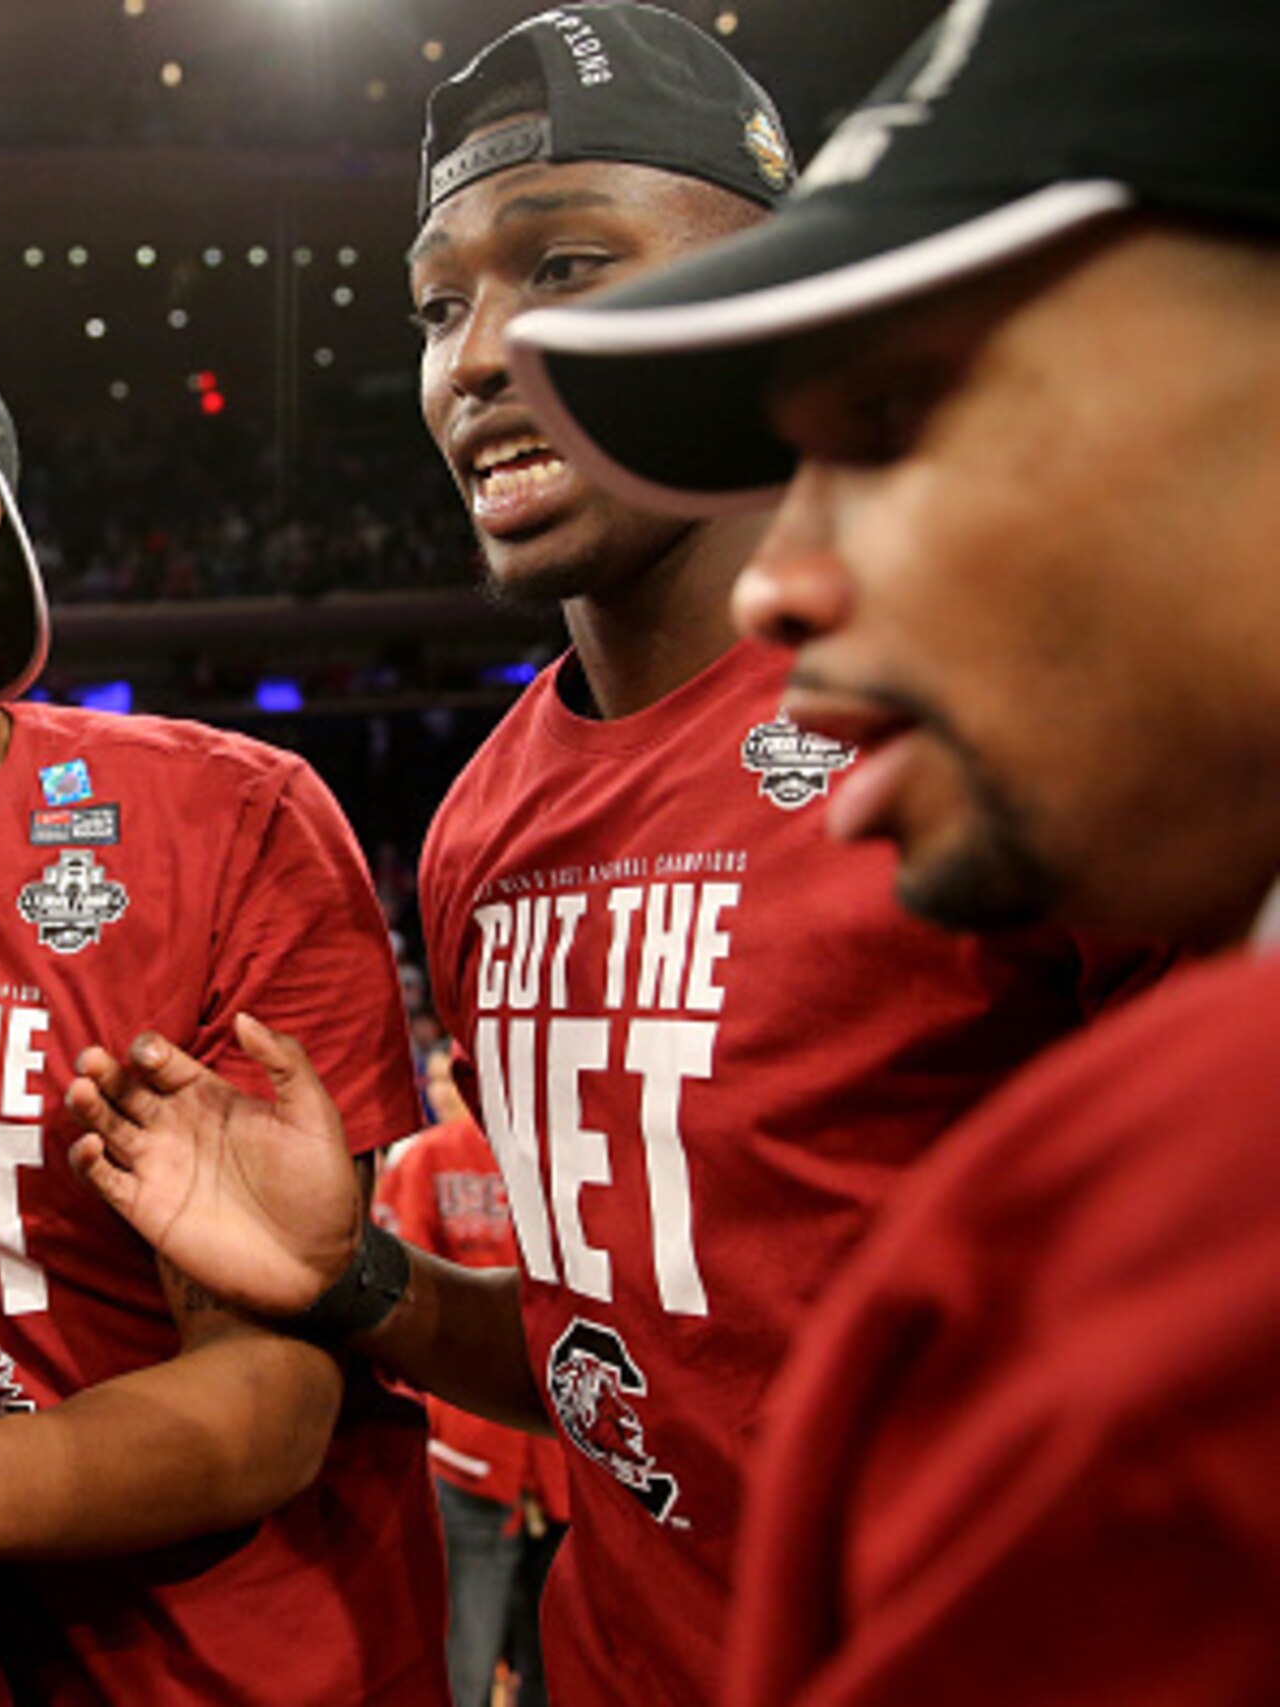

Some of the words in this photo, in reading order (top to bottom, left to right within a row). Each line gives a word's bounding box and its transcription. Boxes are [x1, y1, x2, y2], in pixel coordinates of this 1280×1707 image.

[473, 891, 587, 1010] CUT
[605, 883, 740, 1012] THE
[475, 1017, 718, 1316] NET
